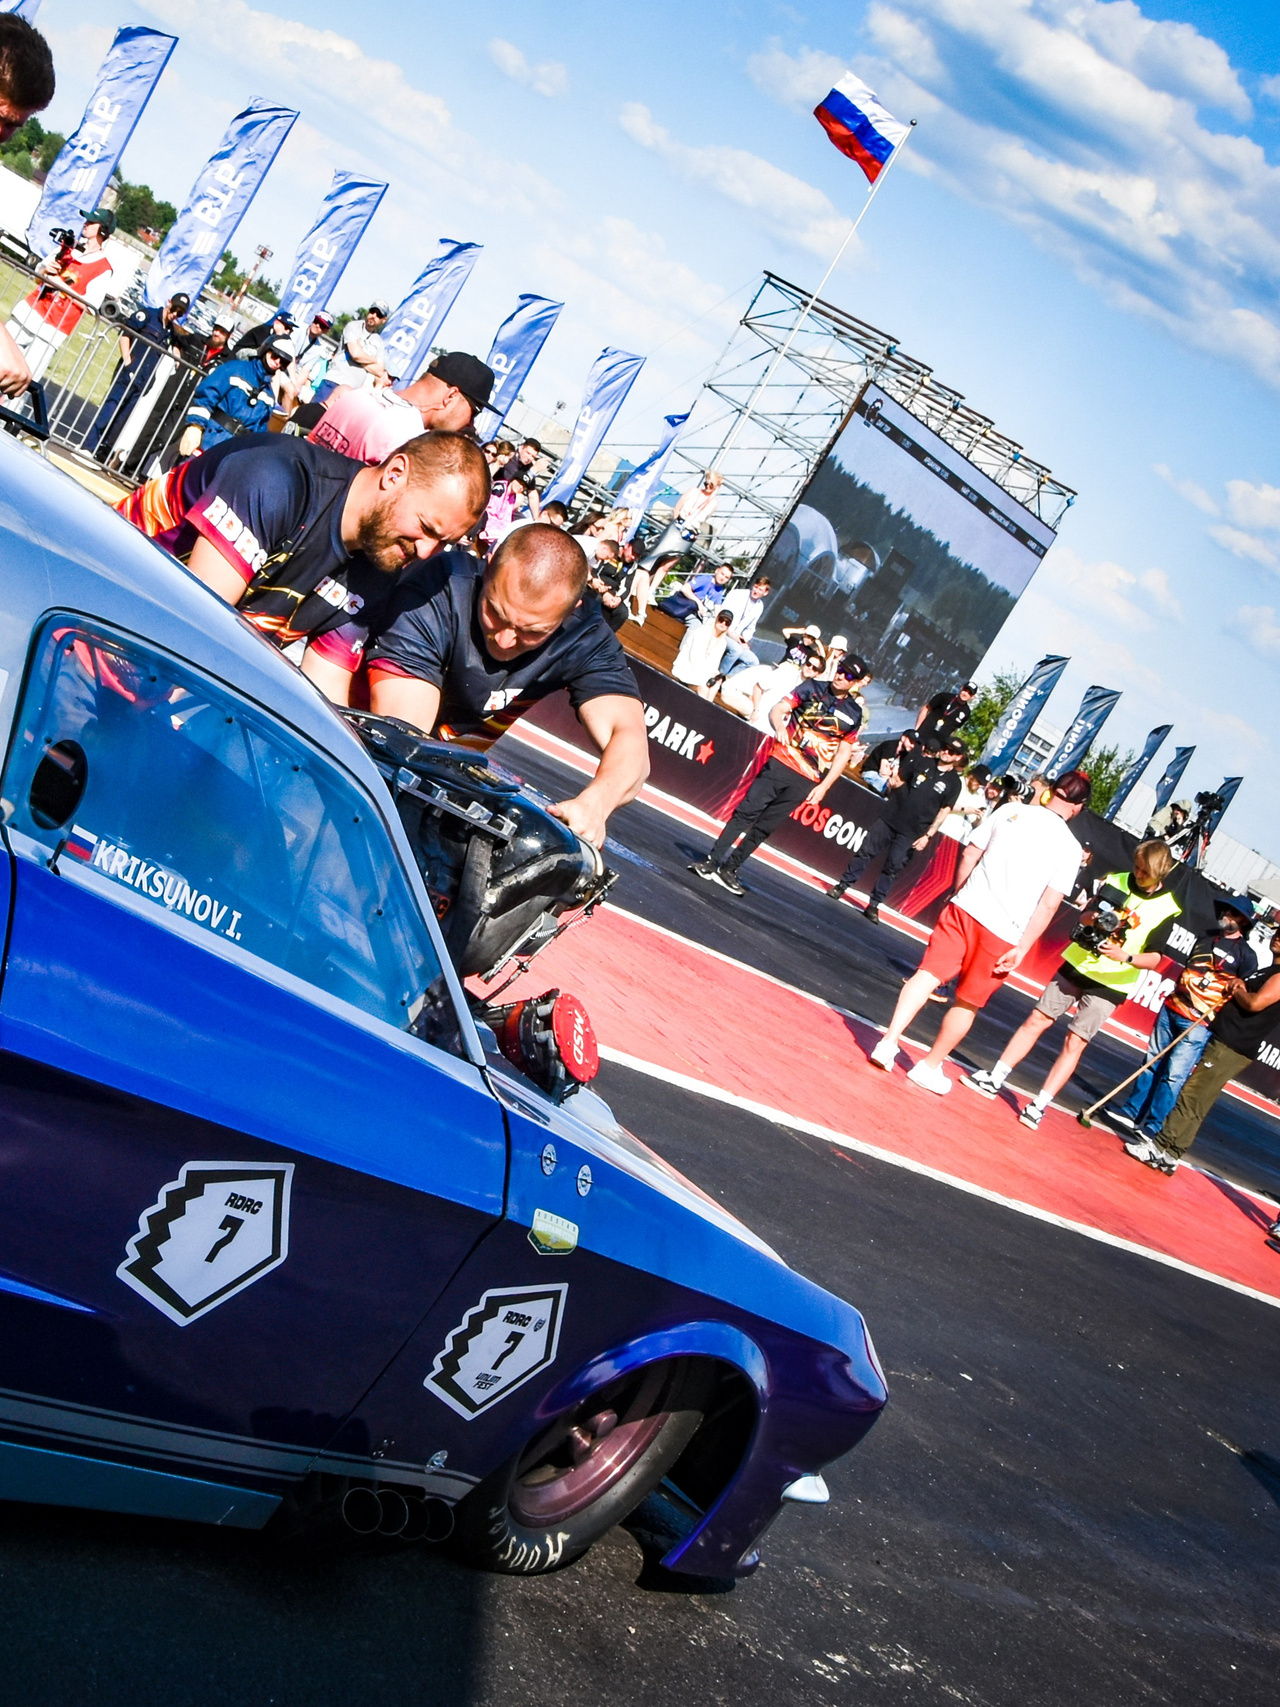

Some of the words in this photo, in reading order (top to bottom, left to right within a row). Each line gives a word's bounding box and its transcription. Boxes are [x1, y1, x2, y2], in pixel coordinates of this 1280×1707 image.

[93, 840, 228, 929] KRIKSUNOV
[225, 909, 242, 941] I.
[573, 1009, 584, 1065] MSD
[224, 1192, 263, 1215] RDRC
[204, 1214, 245, 1263] 7
[502, 1311, 532, 1328] RDRC
[491, 1331, 525, 1370] 7
